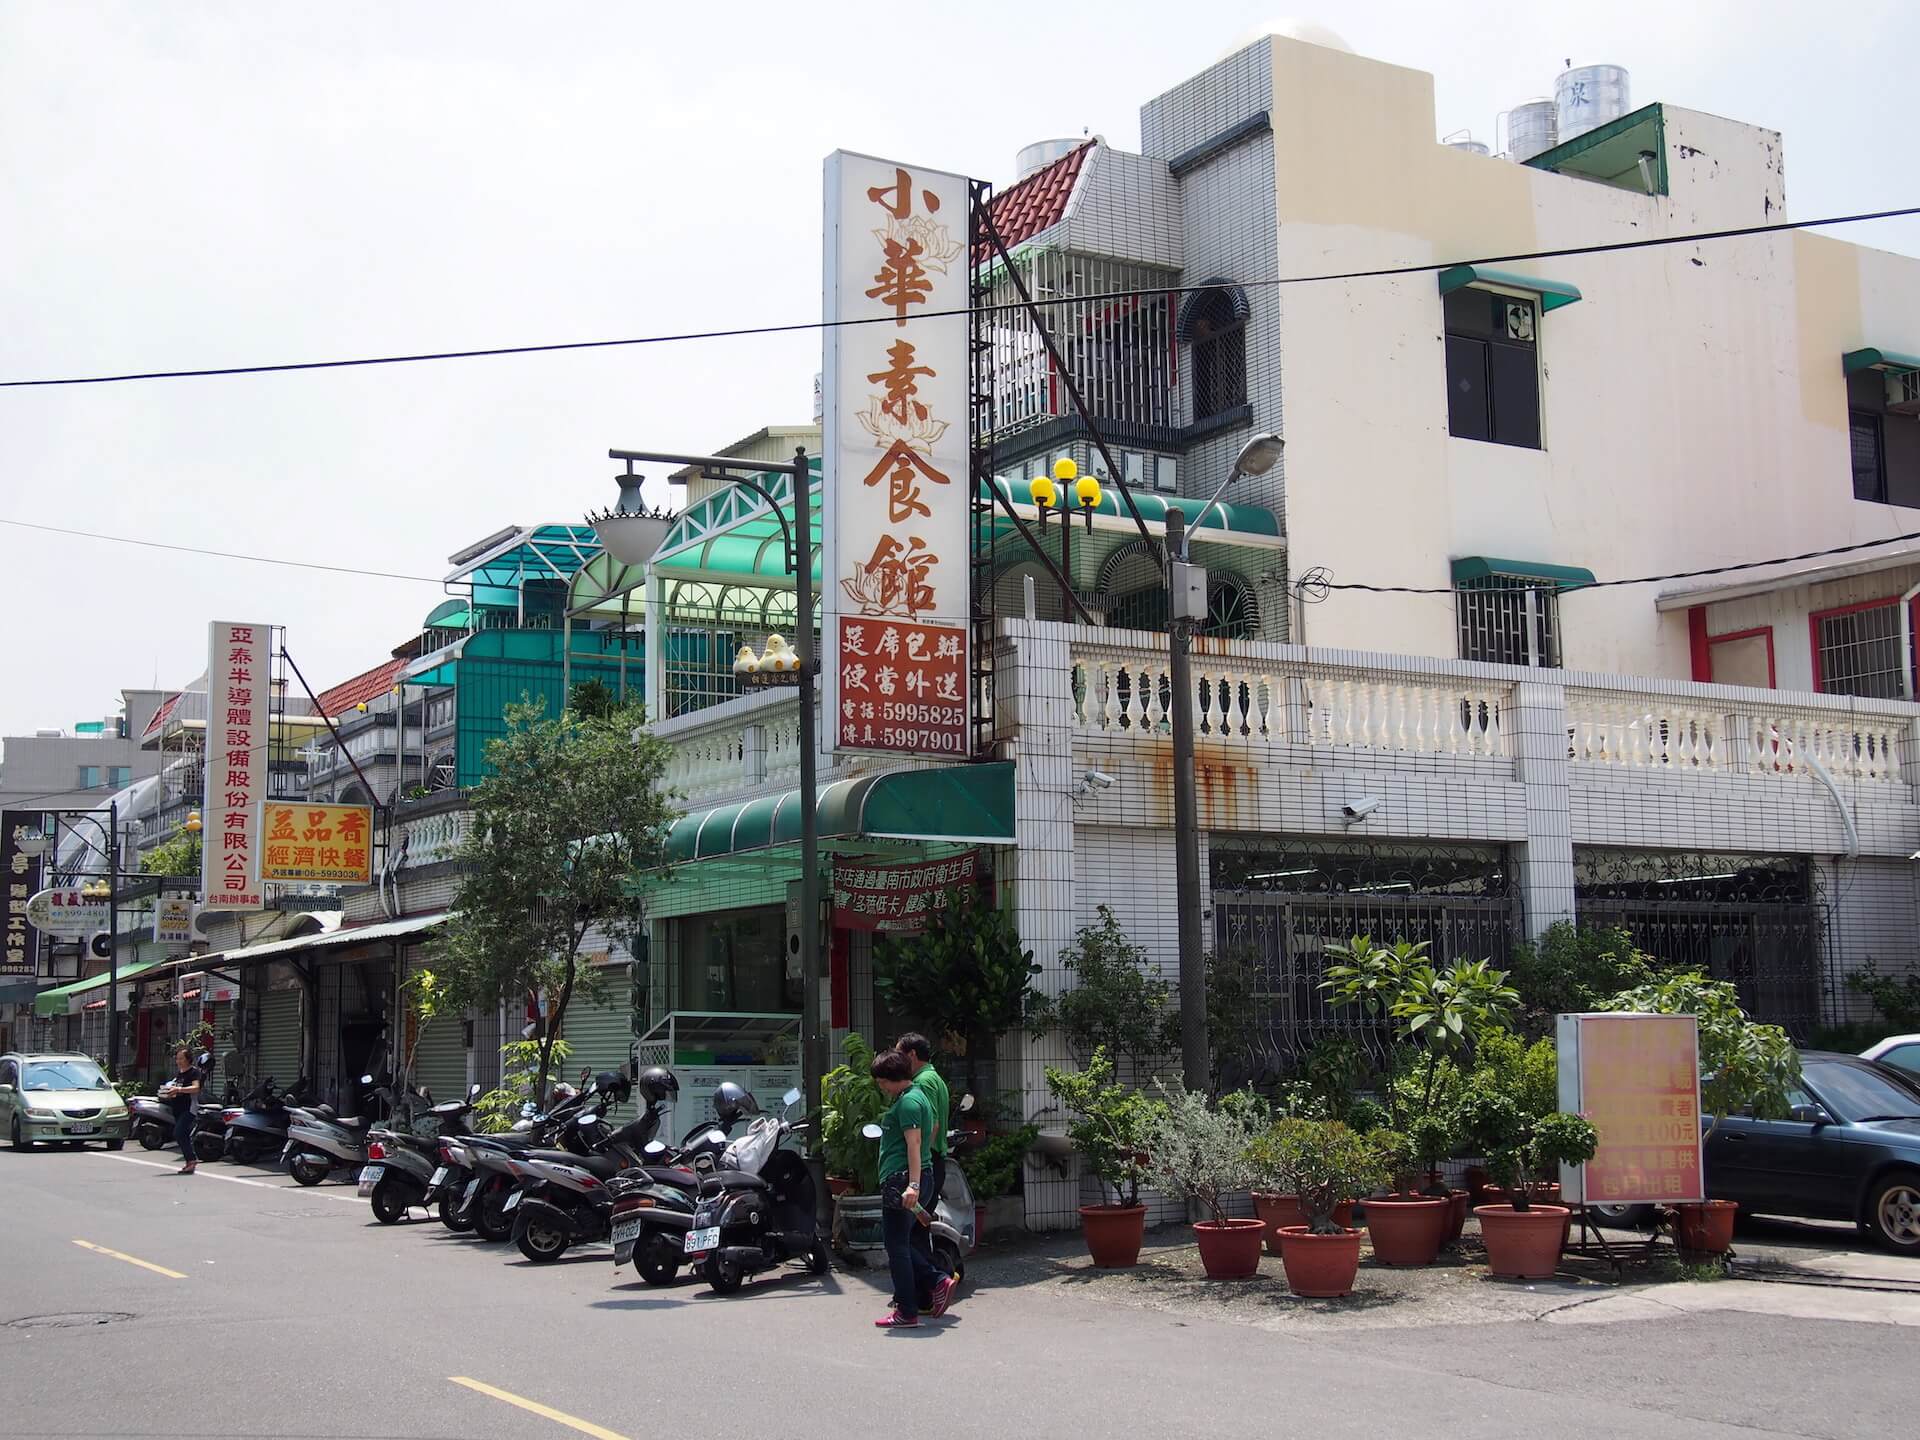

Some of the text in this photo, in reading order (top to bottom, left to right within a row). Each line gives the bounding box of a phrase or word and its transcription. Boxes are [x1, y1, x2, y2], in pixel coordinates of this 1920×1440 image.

[864, 167, 951, 613] 小華素食館
[842, 663, 964, 701] 便當外送
[223, 627, 254, 891] 亞泰半導體設備股份有限公司
[268, 809, 366, 843] 益品香
[267, 845, 366, 868] 經濟快餐
[208, 893, 261, 905] 台南辦事處
